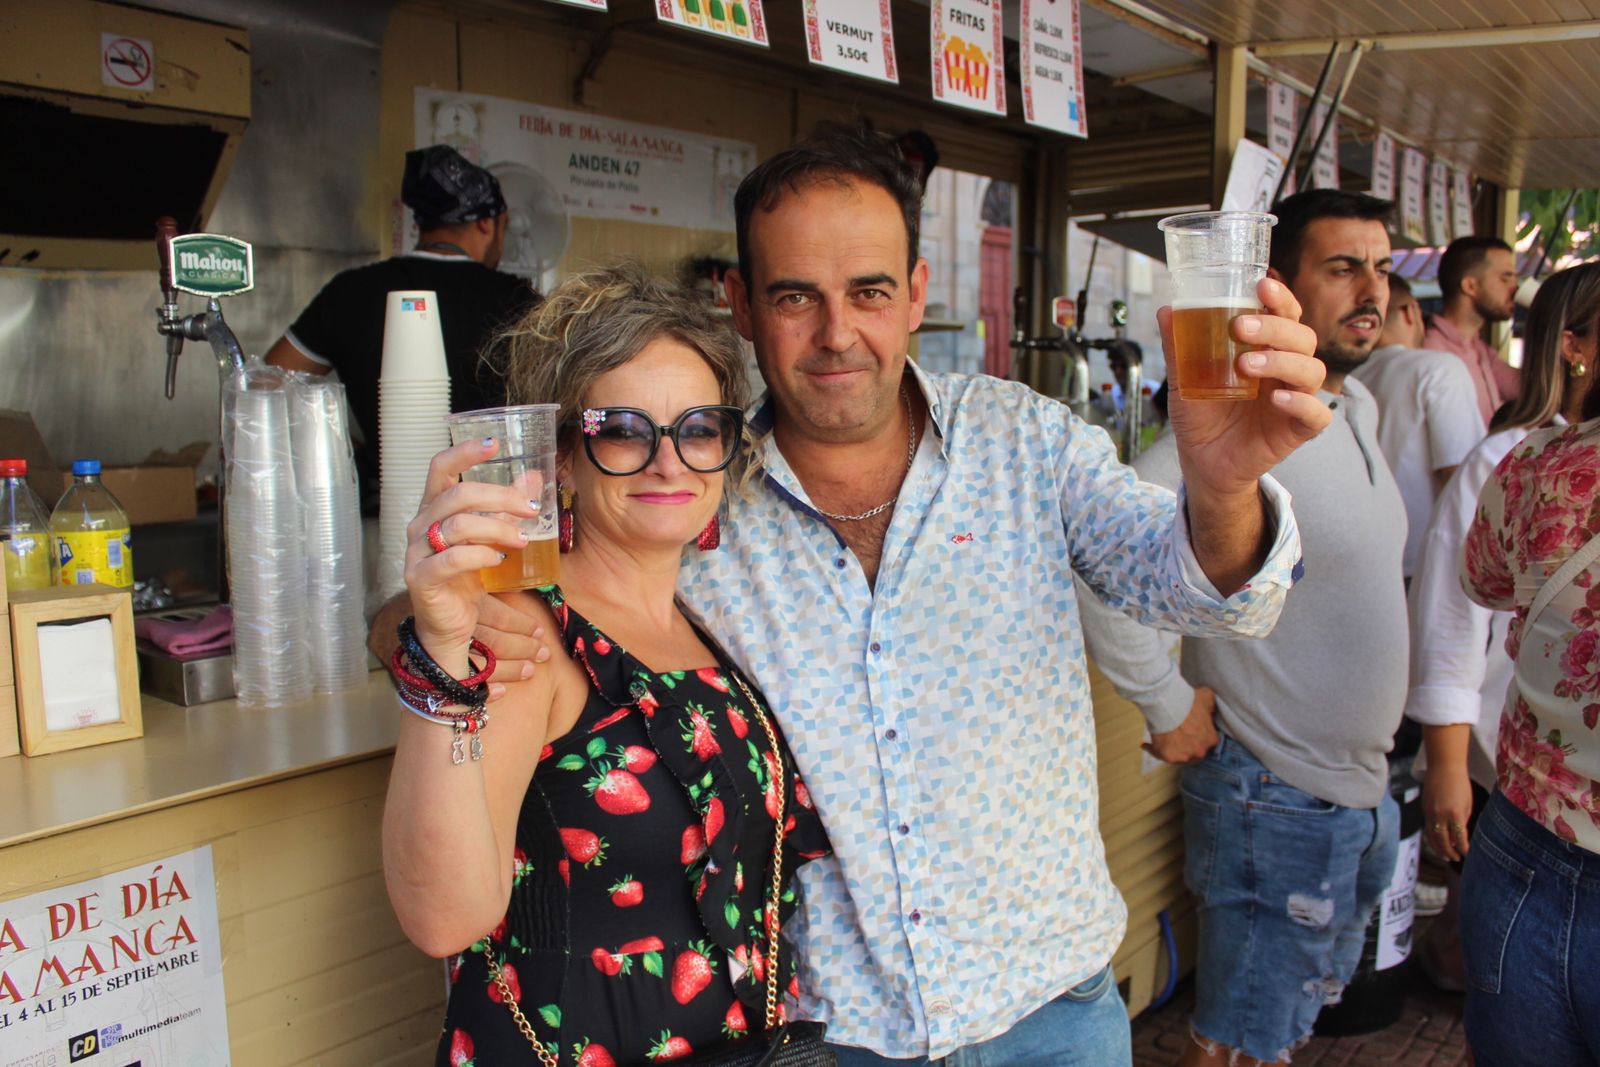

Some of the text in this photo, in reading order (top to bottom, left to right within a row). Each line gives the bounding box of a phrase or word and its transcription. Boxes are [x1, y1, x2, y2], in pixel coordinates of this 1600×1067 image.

[826, 19, 874, 42] VERMUT
[950, 8, 985, 31] FRITAS
[837, 44, 868, 63] 3,50€
[559, 122, 573, 138] DE
[568, 152, 620, 176] ANDEN
[623, 161, 640, 177] 47
[180, 252, 244, 272] Mahou
[46, 892, 103, 941] DE
[120, 865, 192, 919] DÍA
[19, 1008, 29, 1022] 4
[34, 999, 57, 1017] AL
[62, 991, 77, 1008] 15
[82, 983, 103, 1001] DE
[72, 1034, 97, 1058] CD
